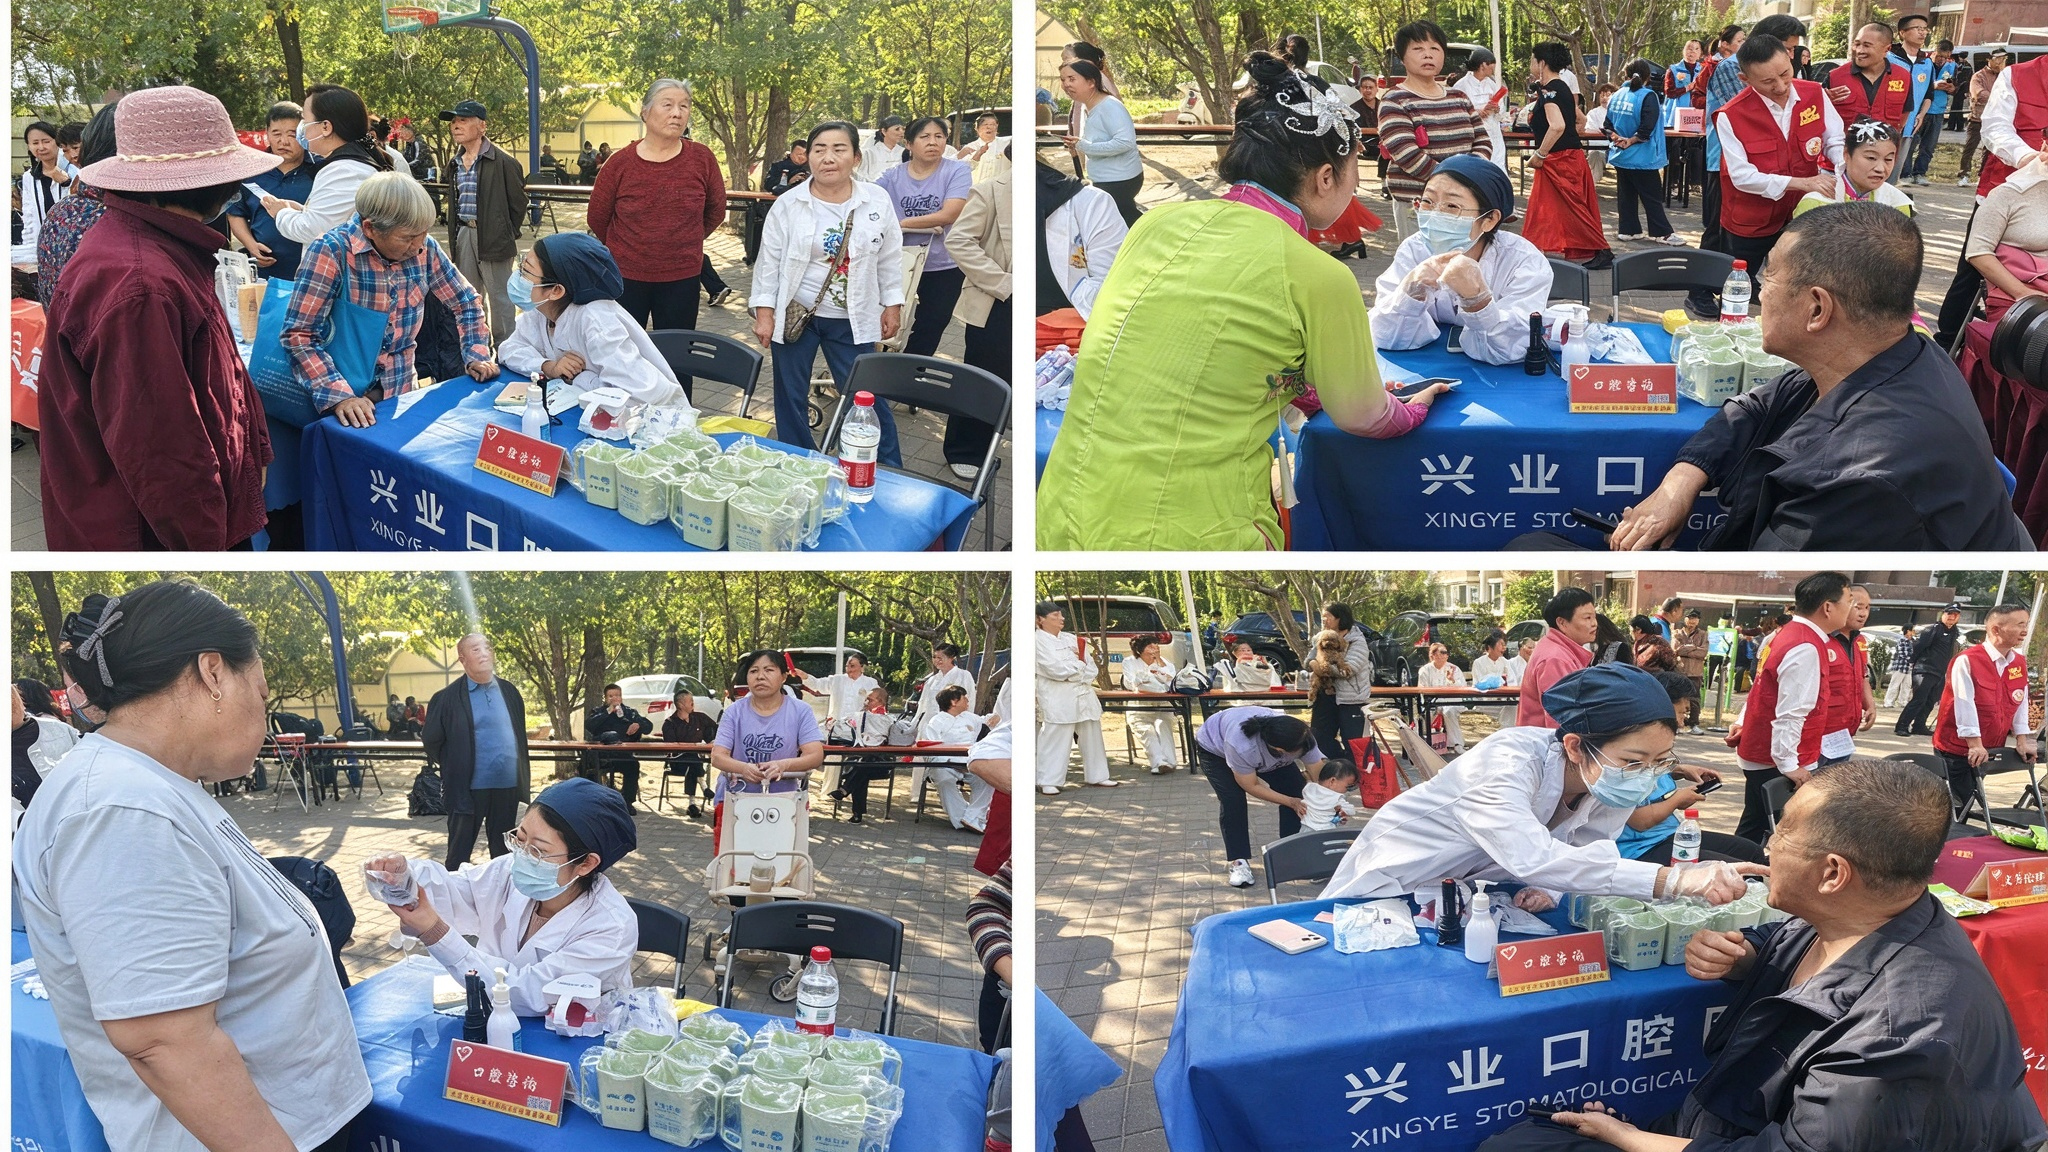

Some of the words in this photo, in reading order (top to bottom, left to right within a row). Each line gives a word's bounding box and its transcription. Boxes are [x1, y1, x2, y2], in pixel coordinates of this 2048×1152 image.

[370, 469, 552, 552] 兴业口
[1424, 512, 1517, 528] XINGYE
[1351, 1112, 1459, 1149] XINGYE
